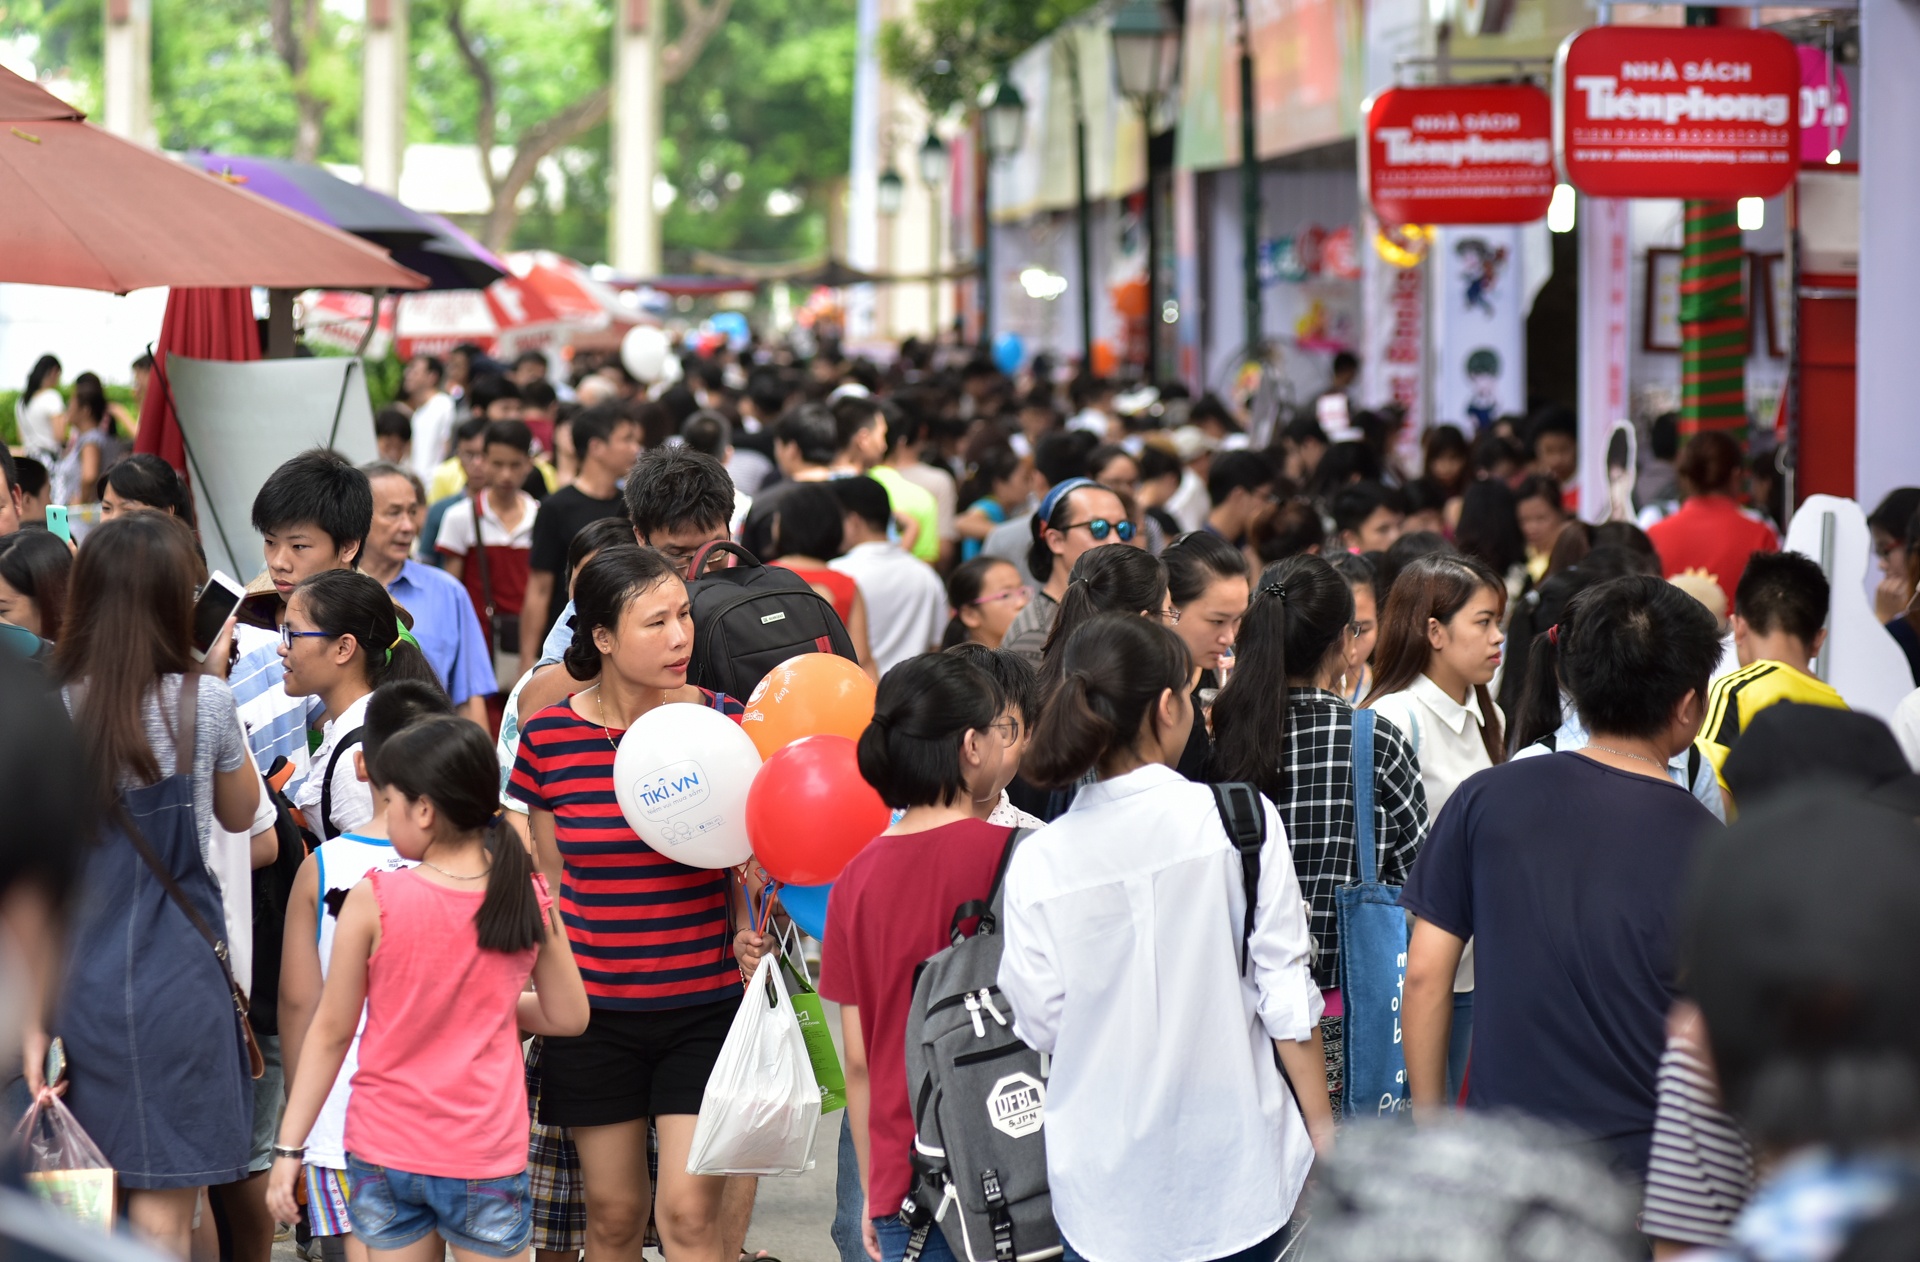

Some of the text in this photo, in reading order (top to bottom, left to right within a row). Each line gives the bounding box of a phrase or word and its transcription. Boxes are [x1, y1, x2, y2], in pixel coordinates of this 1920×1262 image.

[1621, 57, 1751, 82] NHÀ SÁCH
[673, 796, 687, 805] mua
